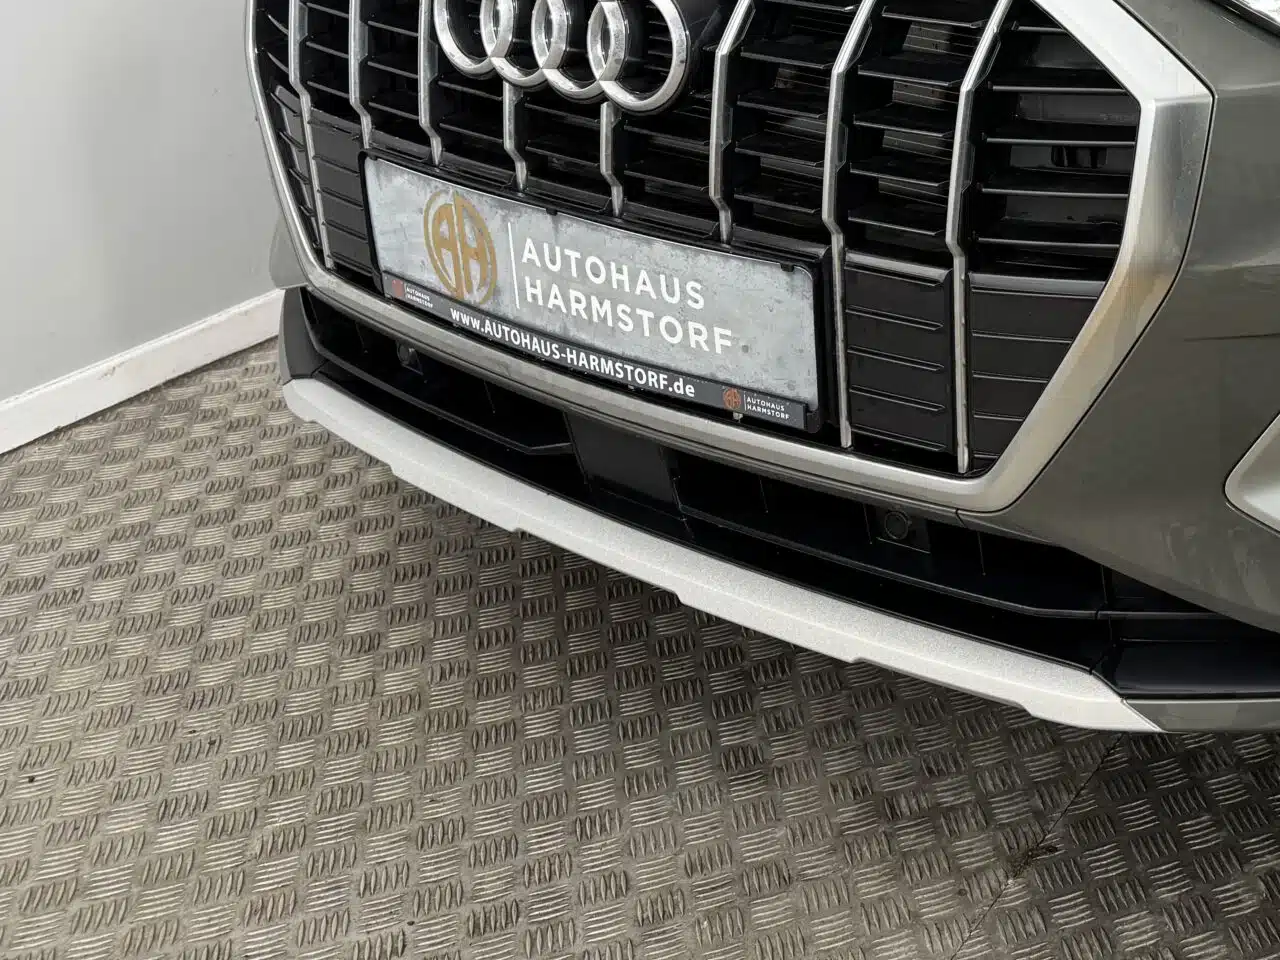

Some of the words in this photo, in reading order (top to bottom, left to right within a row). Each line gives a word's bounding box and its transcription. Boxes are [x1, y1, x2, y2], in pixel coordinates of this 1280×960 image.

[521, 237, 705, 310] AUTOHAUS
[524, 275, 733, 355] HARMSTORF
[450, 307, 696, 398] www.AUTOHAUS-HARMSTORF.de
[746, 396, 785, 412] AUTOHAUS
[747, 404, 790, 420] HARMSTORF
